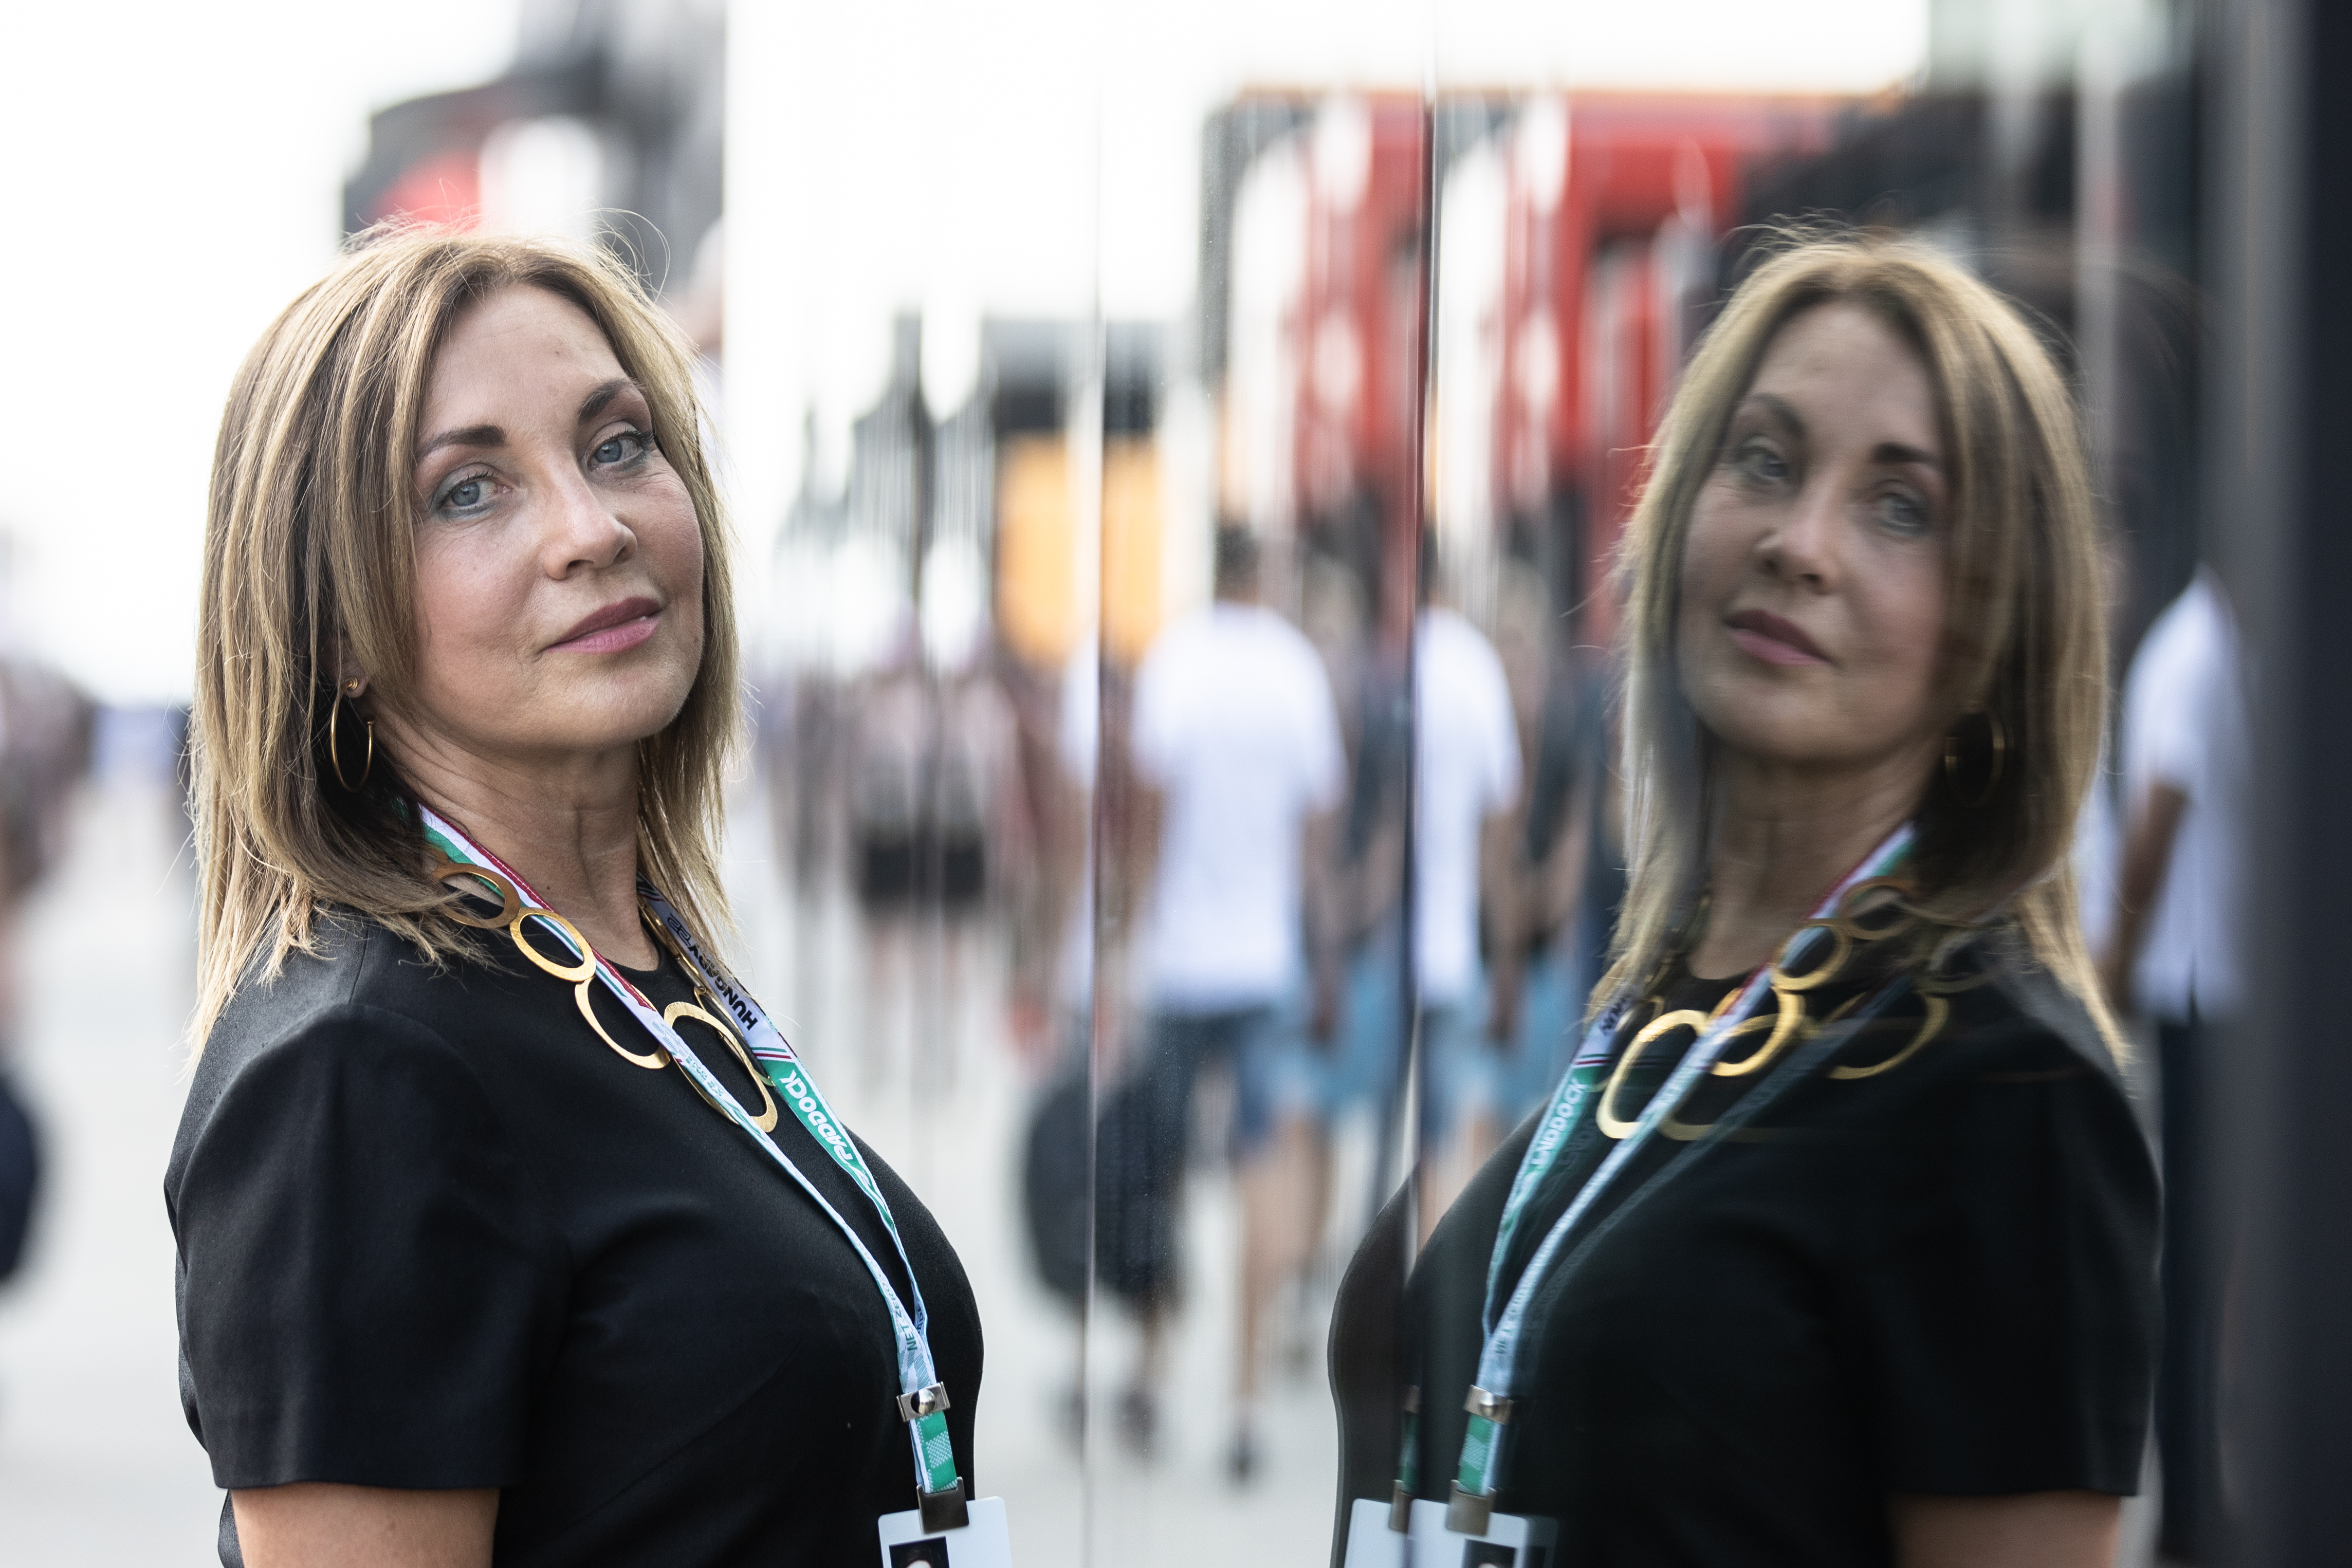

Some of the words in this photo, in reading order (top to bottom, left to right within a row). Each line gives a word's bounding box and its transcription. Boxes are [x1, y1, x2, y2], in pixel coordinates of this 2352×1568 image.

[779, 1069, 853, 1165] PADDOCK
[882, 1283, 902, 1317] ZERO
[915, 1303, 923, 1334] ADE
[899, 1323, 917, 1351] NET
